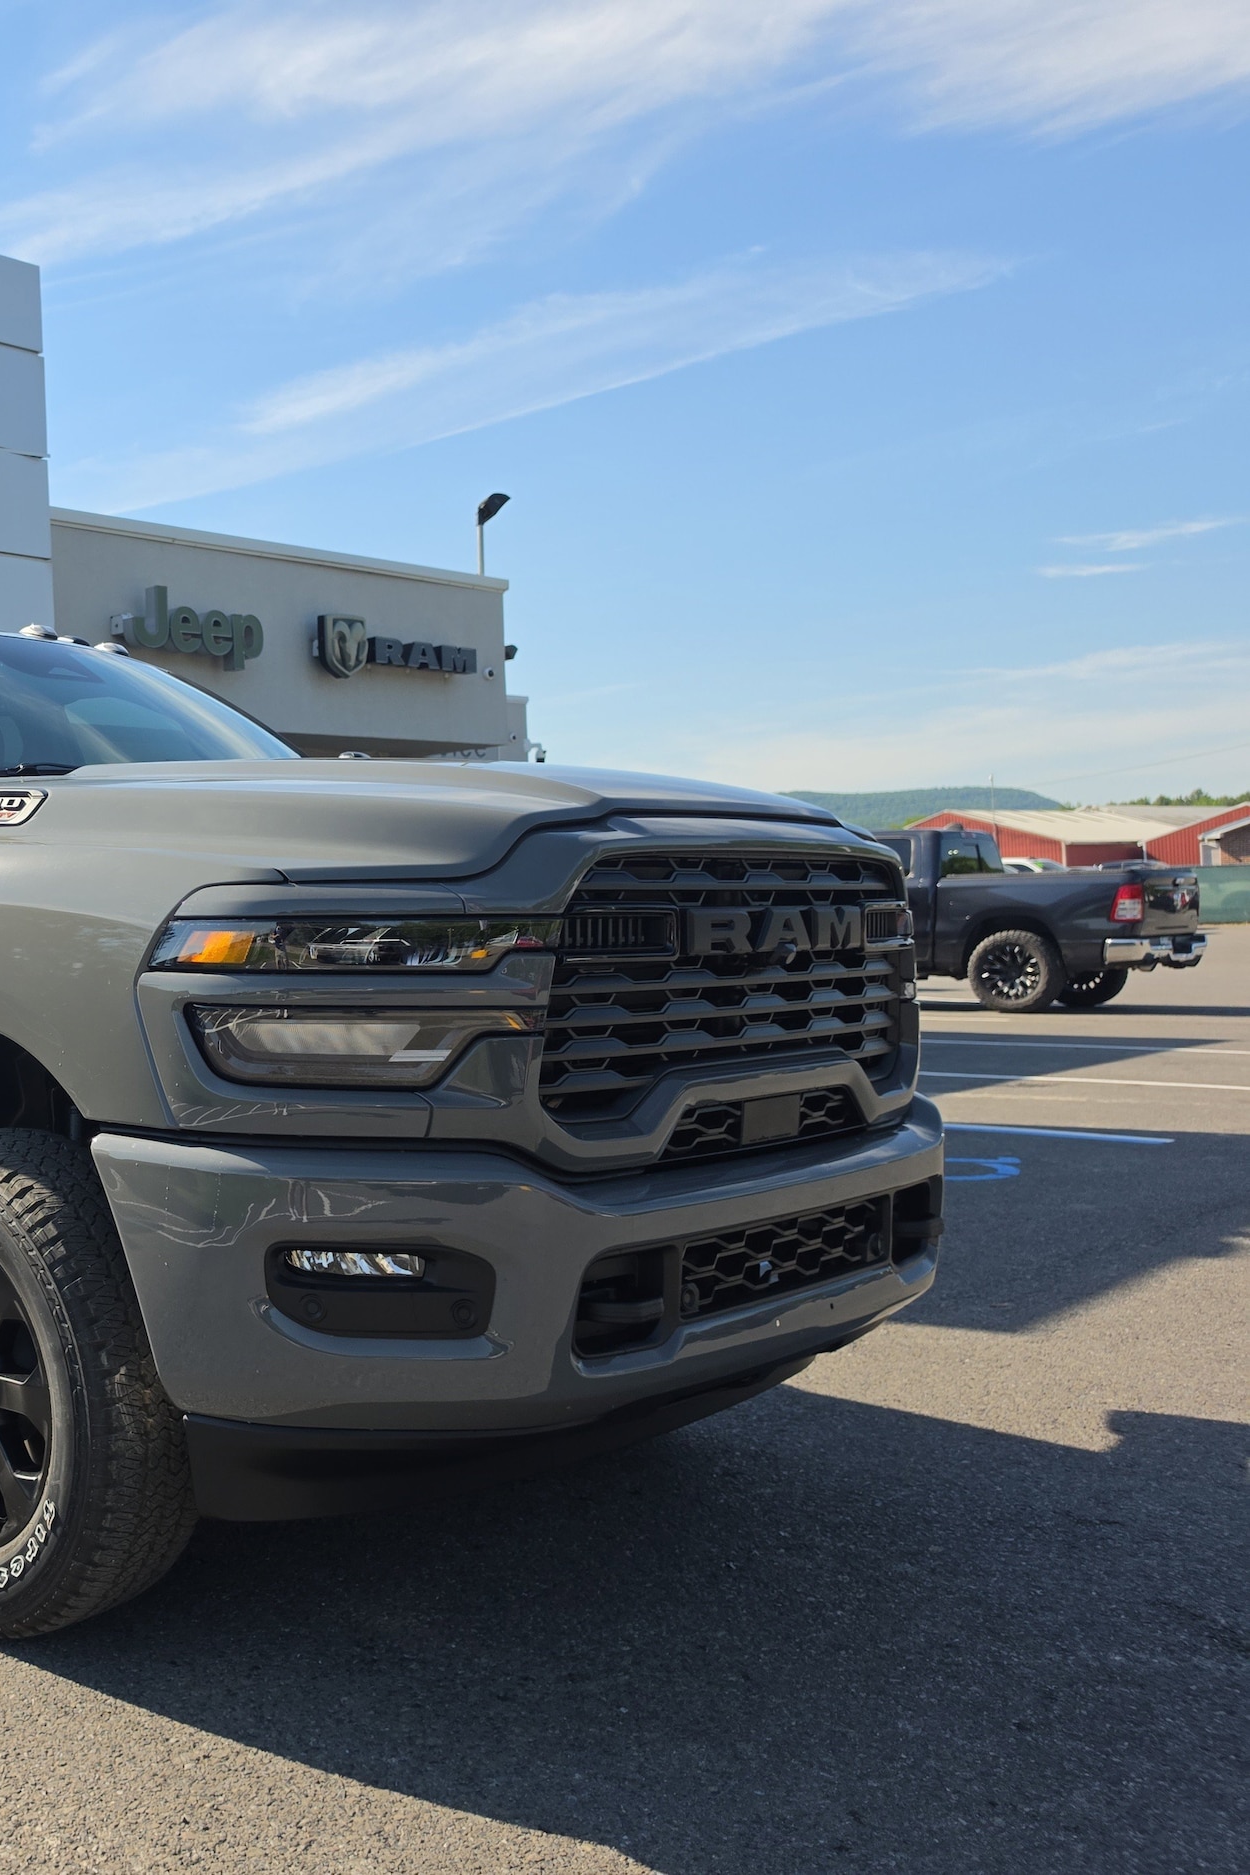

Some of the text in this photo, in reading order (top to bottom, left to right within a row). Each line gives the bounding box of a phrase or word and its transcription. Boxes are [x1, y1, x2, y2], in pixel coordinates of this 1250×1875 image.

[124, 585, 264, 672] Jeep
[367, 636, 478, 675] RAM
[687, 904, 862, 957] RAM
